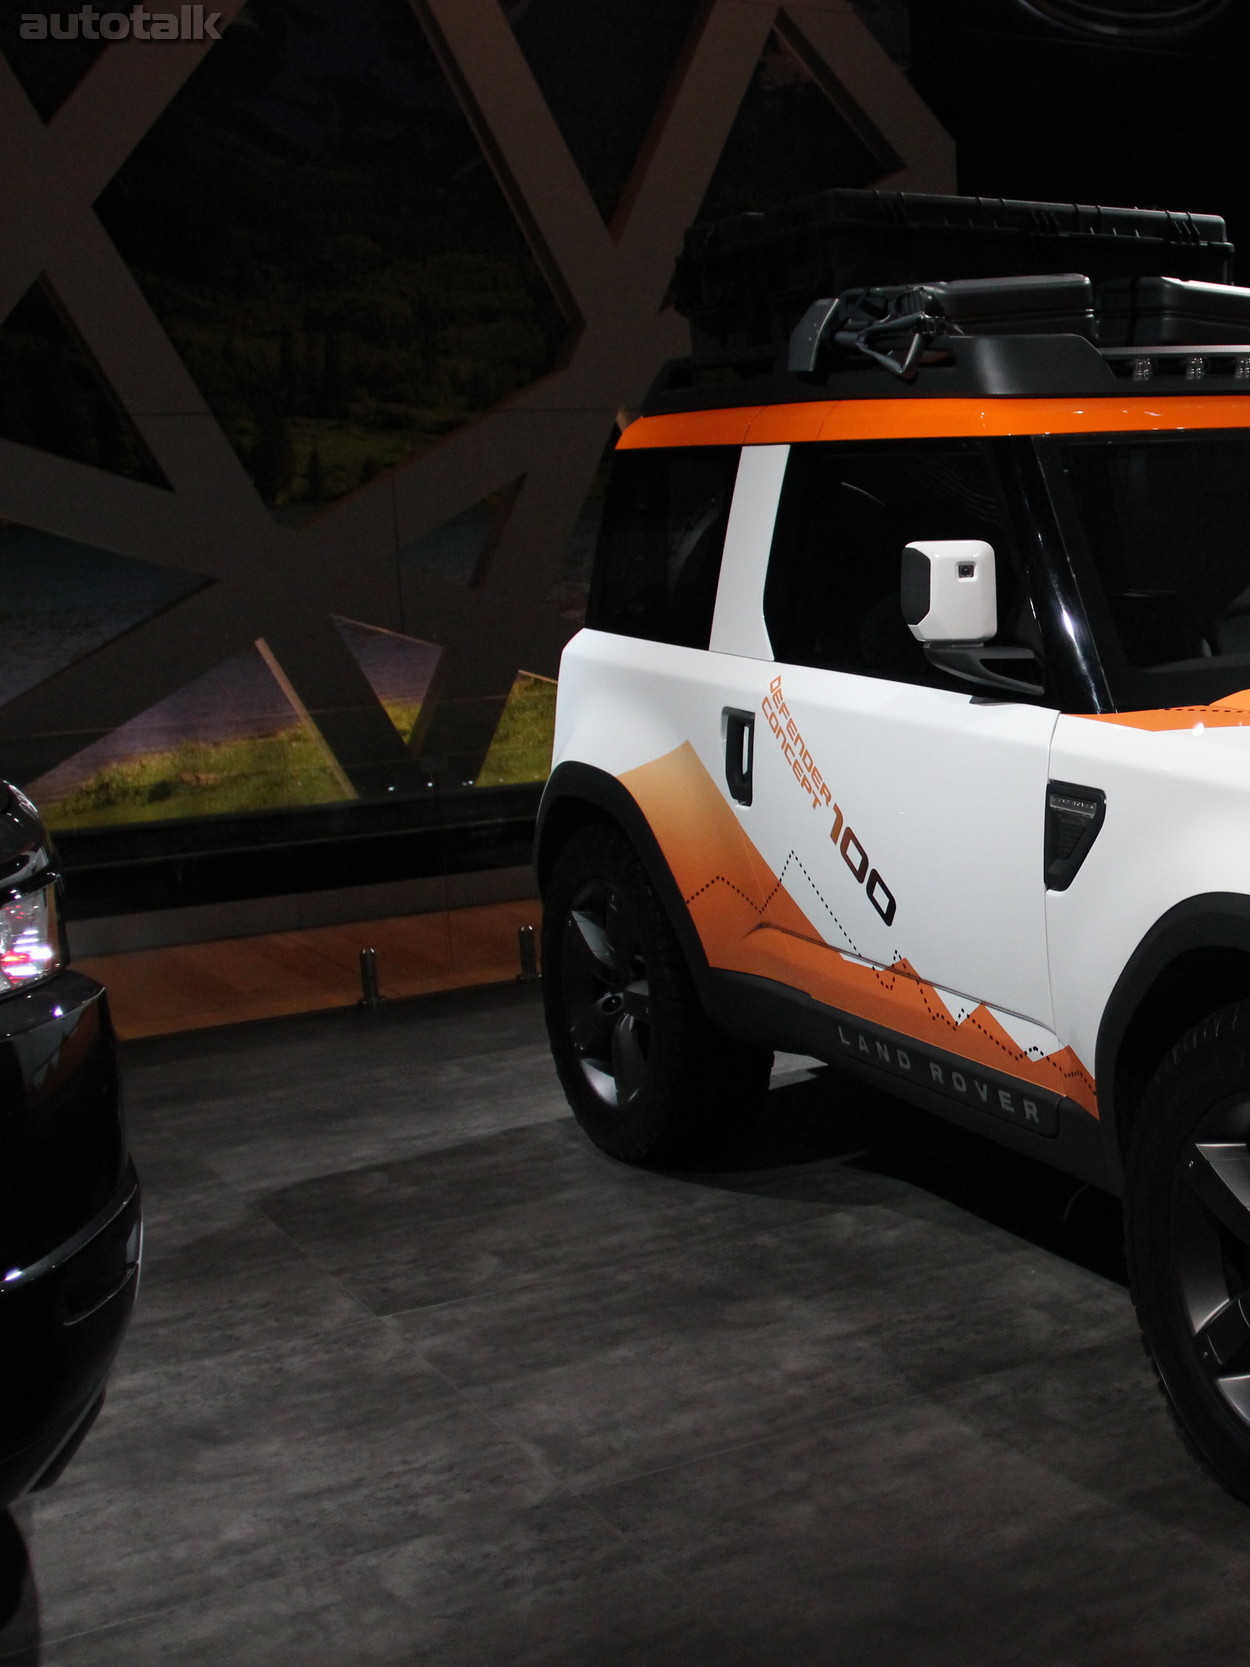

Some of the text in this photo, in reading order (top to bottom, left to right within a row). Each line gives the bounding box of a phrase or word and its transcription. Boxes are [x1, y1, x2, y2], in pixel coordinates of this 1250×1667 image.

[761, 696, 822, 810] CONCEPT
[770, 675, 897, 927] DEFENDER 100
[837, 1025, 1040, 1124] LAND ROVER
